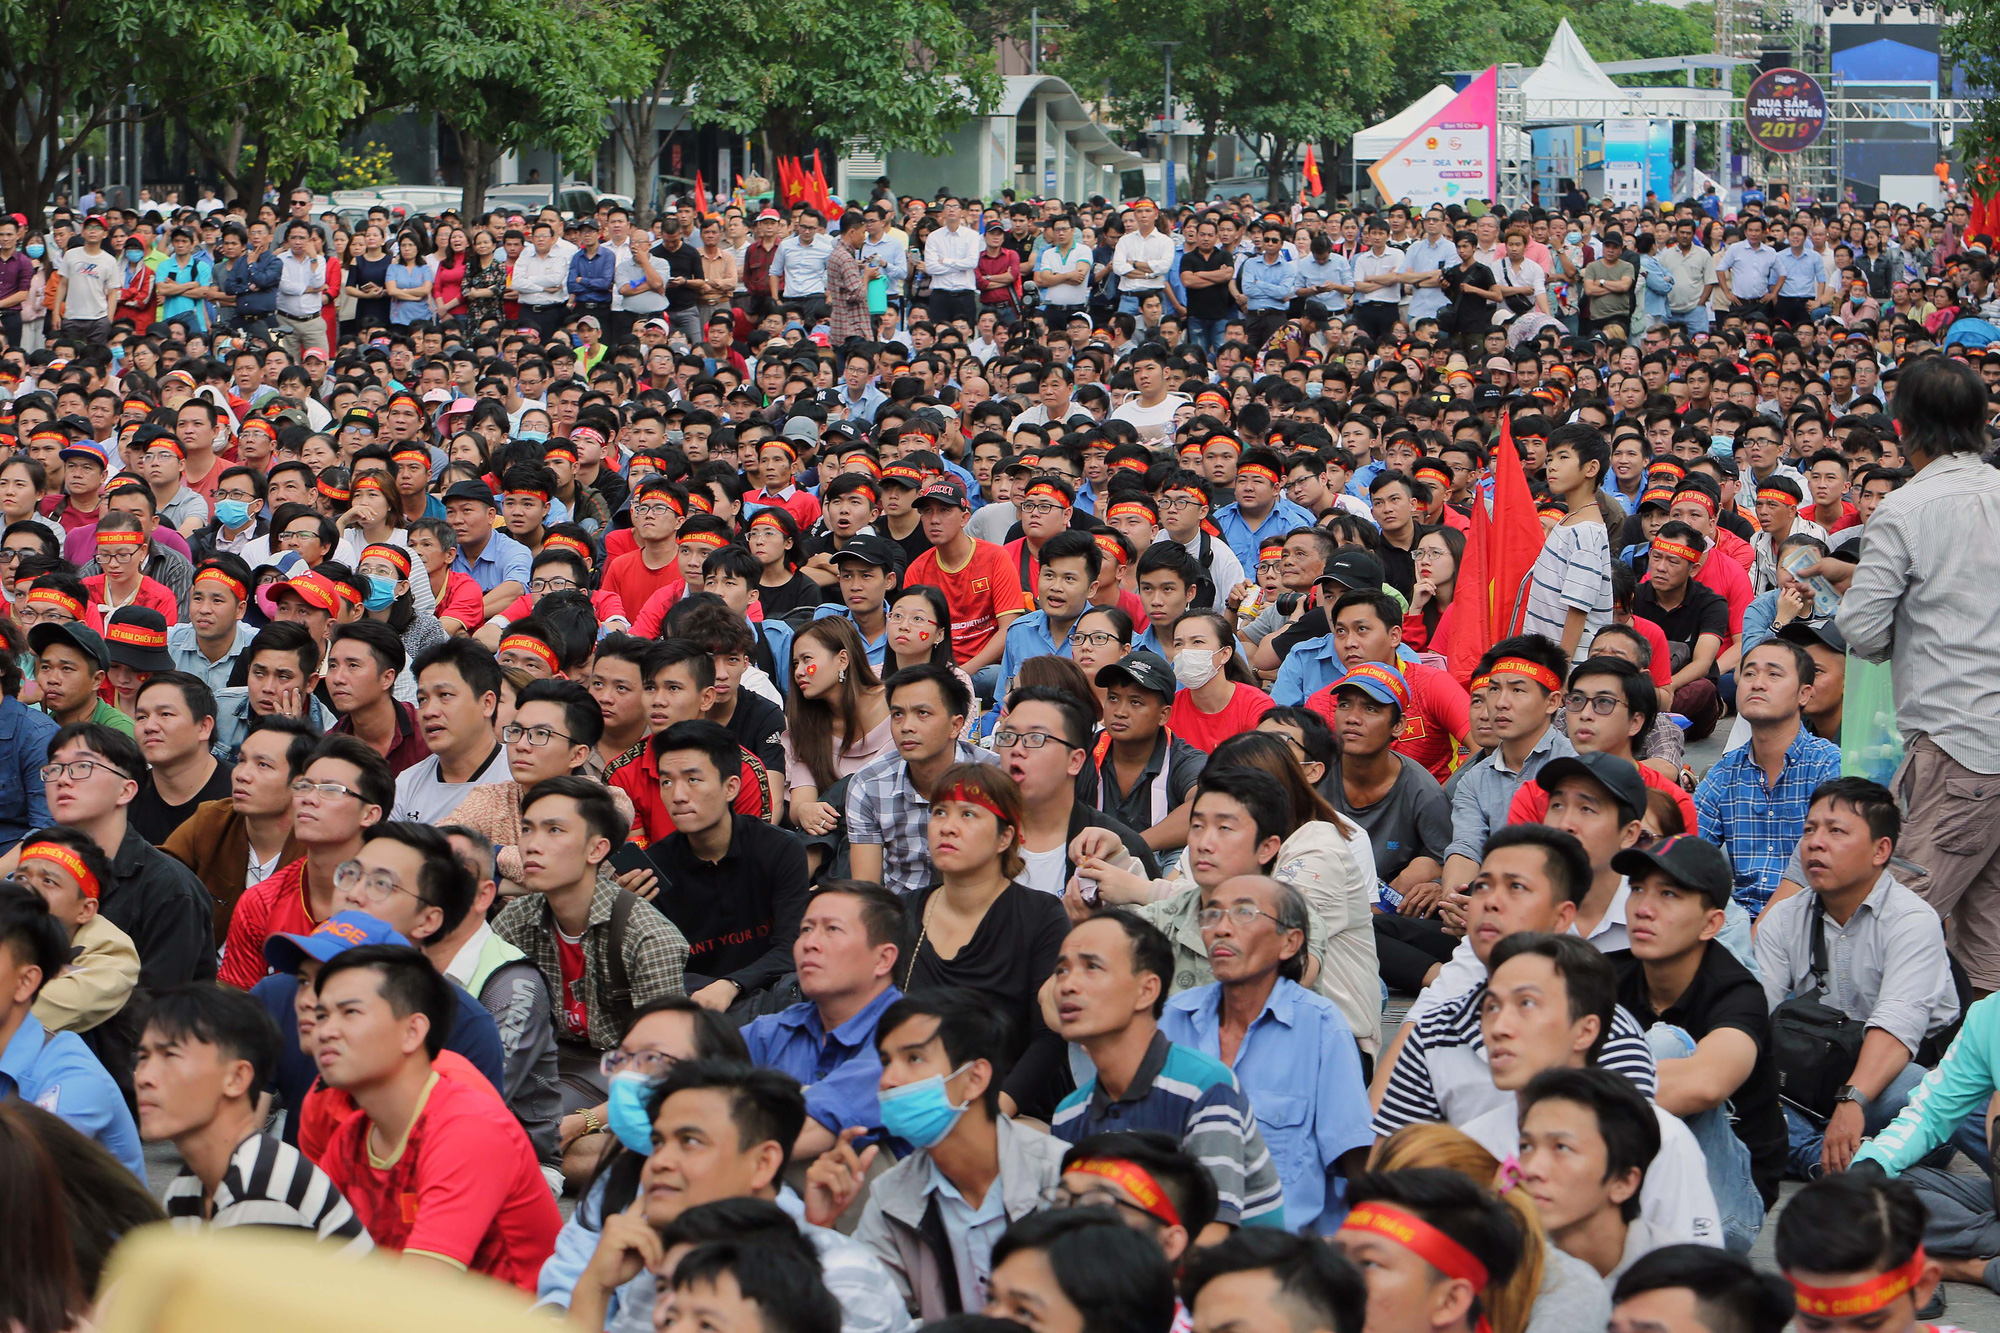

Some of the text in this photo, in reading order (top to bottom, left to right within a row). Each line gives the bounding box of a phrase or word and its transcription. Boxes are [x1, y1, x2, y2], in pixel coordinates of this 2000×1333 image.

[1757, 98, 1782, 108] MUA
[1759, 122, 1810, 138] 2019
[374, 548, 389, 559] CHIẾN
[389, 550, 405, 567] THẮNG
[302, 580, 319, 594] CHIẾN
[43, 588, 60, 601] CHIẾN
[61, 596, 77, 611] THẮNG
[120, 632, 134, 640] NAM
[134, 631, 151, 642] CHIẾN
[515, 637, 533, 649] CHIẾN
[533, 641, 550, 658] THẮNG
[1498, 659, 1515, 670] CHIẾN
[1515, 661, 1538, 676] THẮNG
[1368, 667, 1387, 681] CHIẾN
[1386, 676, 1404, 696] THẮNG
[38, 845, 63, 859] CHIẾN
[64, 853, 87, 879] THẮNG
[689, 938, 714, 955] ANT
[718, 929, 753, 946] YOUR
